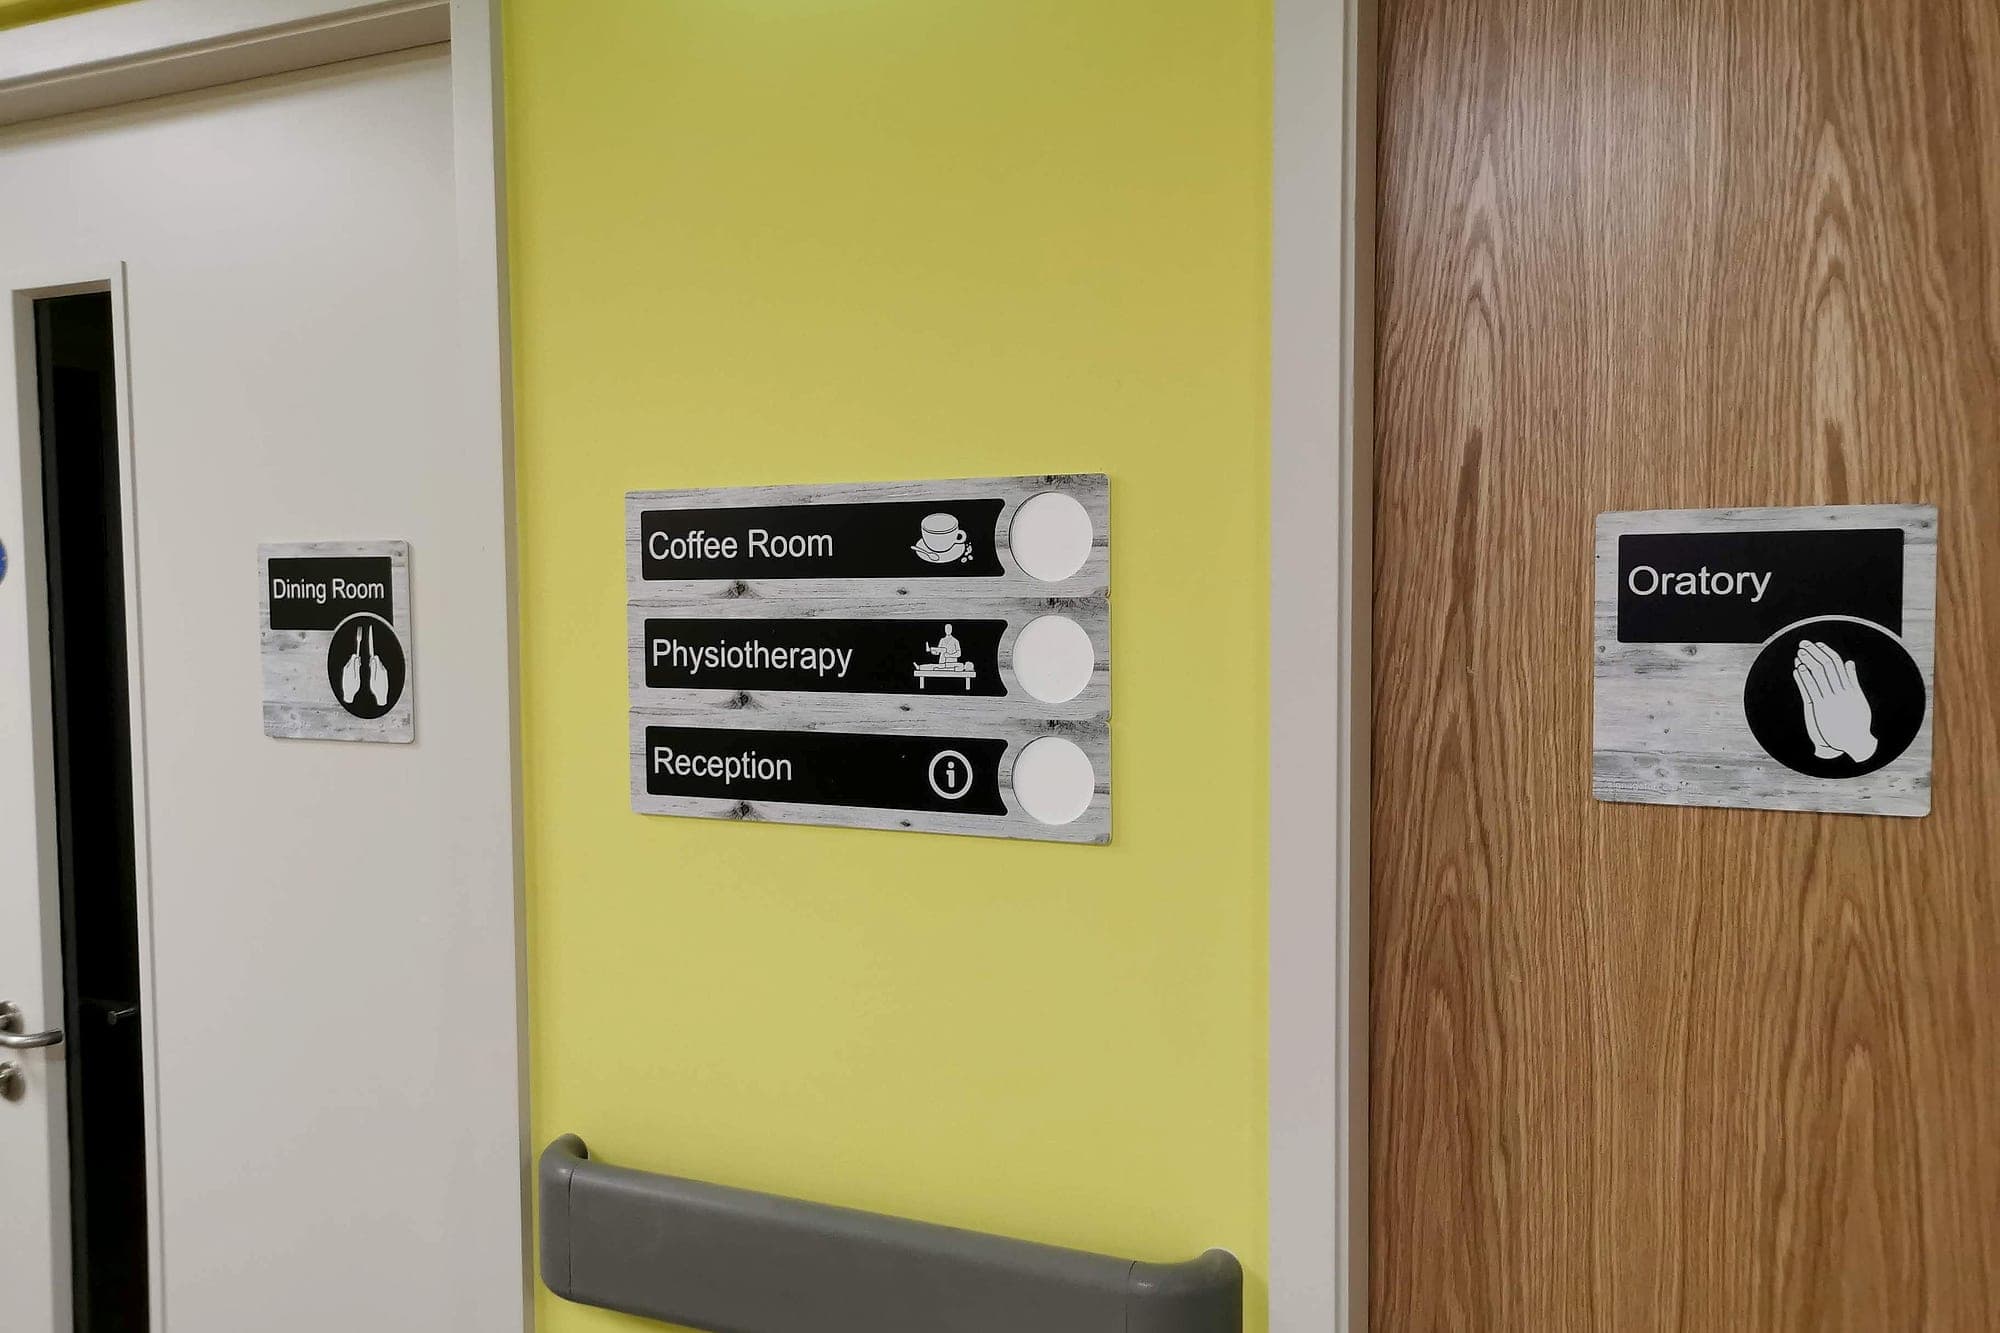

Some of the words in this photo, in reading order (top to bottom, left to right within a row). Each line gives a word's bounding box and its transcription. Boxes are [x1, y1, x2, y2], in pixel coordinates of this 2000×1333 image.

[648, 530, 738, 560] Coffee
[748, 528, 833, 558] Room
[273, 578, 327, 605] Dining
[332, 578, 385, 599] Room
[1628, 565, 1772, 603] Oratory
[652, 638, 853, 678] Physiotherapy
[654, 746, 792, 785] Reception
